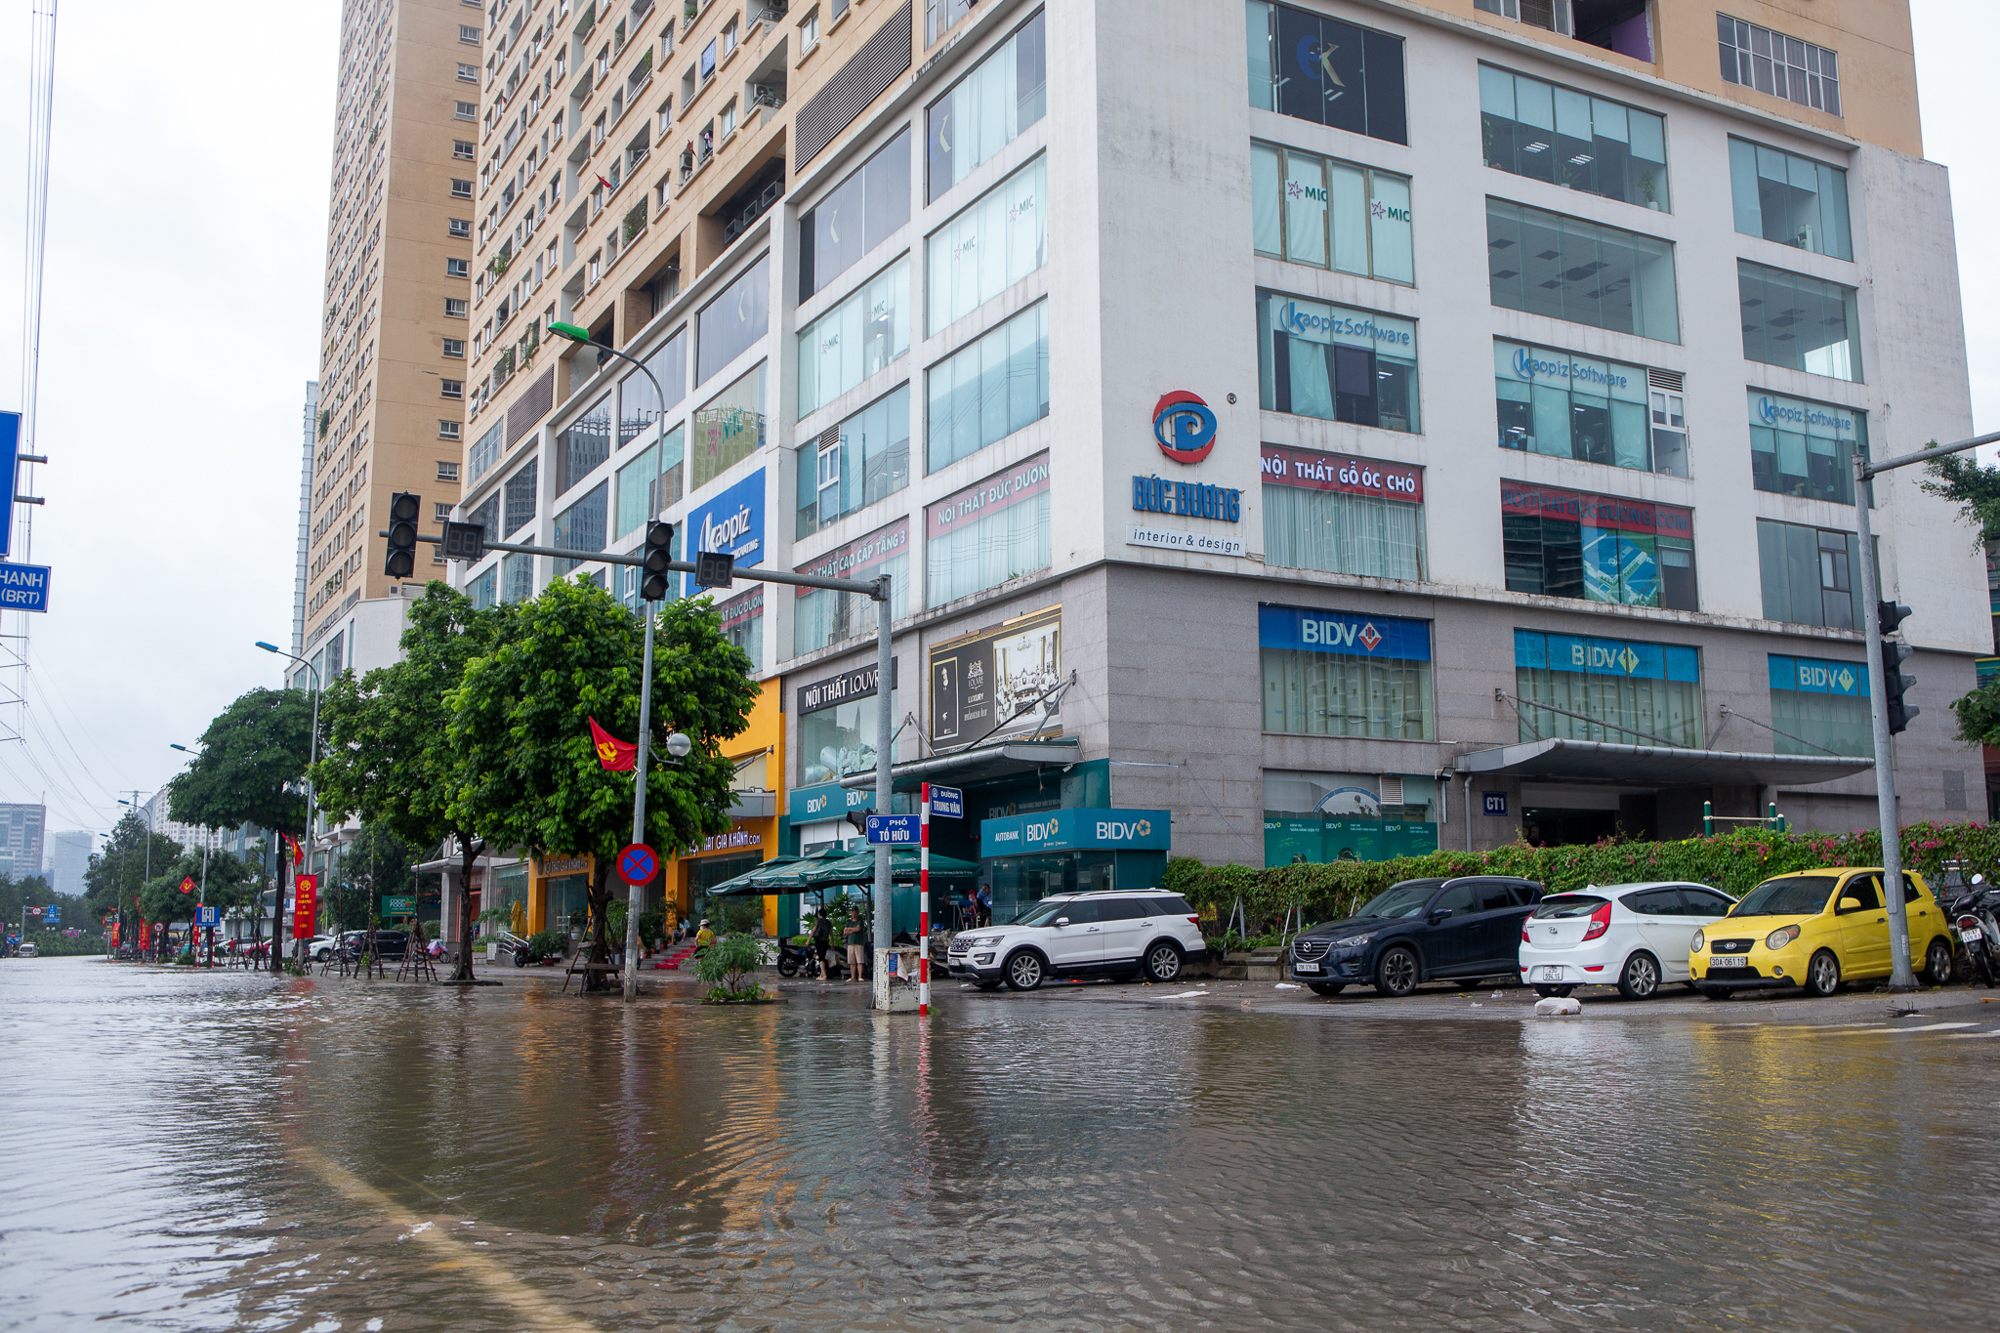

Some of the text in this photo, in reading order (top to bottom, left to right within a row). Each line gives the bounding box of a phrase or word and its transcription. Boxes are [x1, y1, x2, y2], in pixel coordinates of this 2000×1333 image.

[1305, 186, 1327, 202] MIC
[1019, 194, 1034, 215] MIC
[1388, 206, 1410, 222] MIC
[962, 235, 976, 255] MIC
[873, 300, 885, 317] MIC
[827, 333, 839, 349] MIC
[1572, 362, 1628, 388] Software
[1805, 408, 1851, 430] Software
[1261, 453, 1416, 493] NỘI THẤT GỖ ÓC CHÓ
[938, 463, 1050, 527] NỘI THẤT ĐỨC DƯƠN
[1133, 473, 1241, 523] ĐỨC DƯƠNG
[839, 553, 856, 571] CAO
[857, 540, 874, 563] CẤP
[875, 532, 899, 555] TẦNG
[900, 529, 907, 544] 3
[1133, 528, 1240, 553] interior & design
[1, 587, 40, 605] (BRT)
[1302, 619, 1358, 647] BIDV
[1571, 644, 1617, 668] BIDV
[1800, 666, 1838, 688] BIDV
[805, 685, 821, 708] NỘI
[822, 675, 847, 702] THẤT
[846, 790, 862, 807] BIDV
[940, 789, 959, 800] ĐƯỜNG
[1486, 796, 1504, 811] CT1
[807, 798, 822, 814] BIDV
[933, 800, 961, 814] TRUNG VĂN
[889, 817, 908, 826] PHỐ
[879, 826, 910, 842] TỐ HỮU
[994, 822, 1051, 842] AUTOBANK BIDV
[1096, 822, 1138, 841] BIDV
[716, 833, 728, 850] GIA
